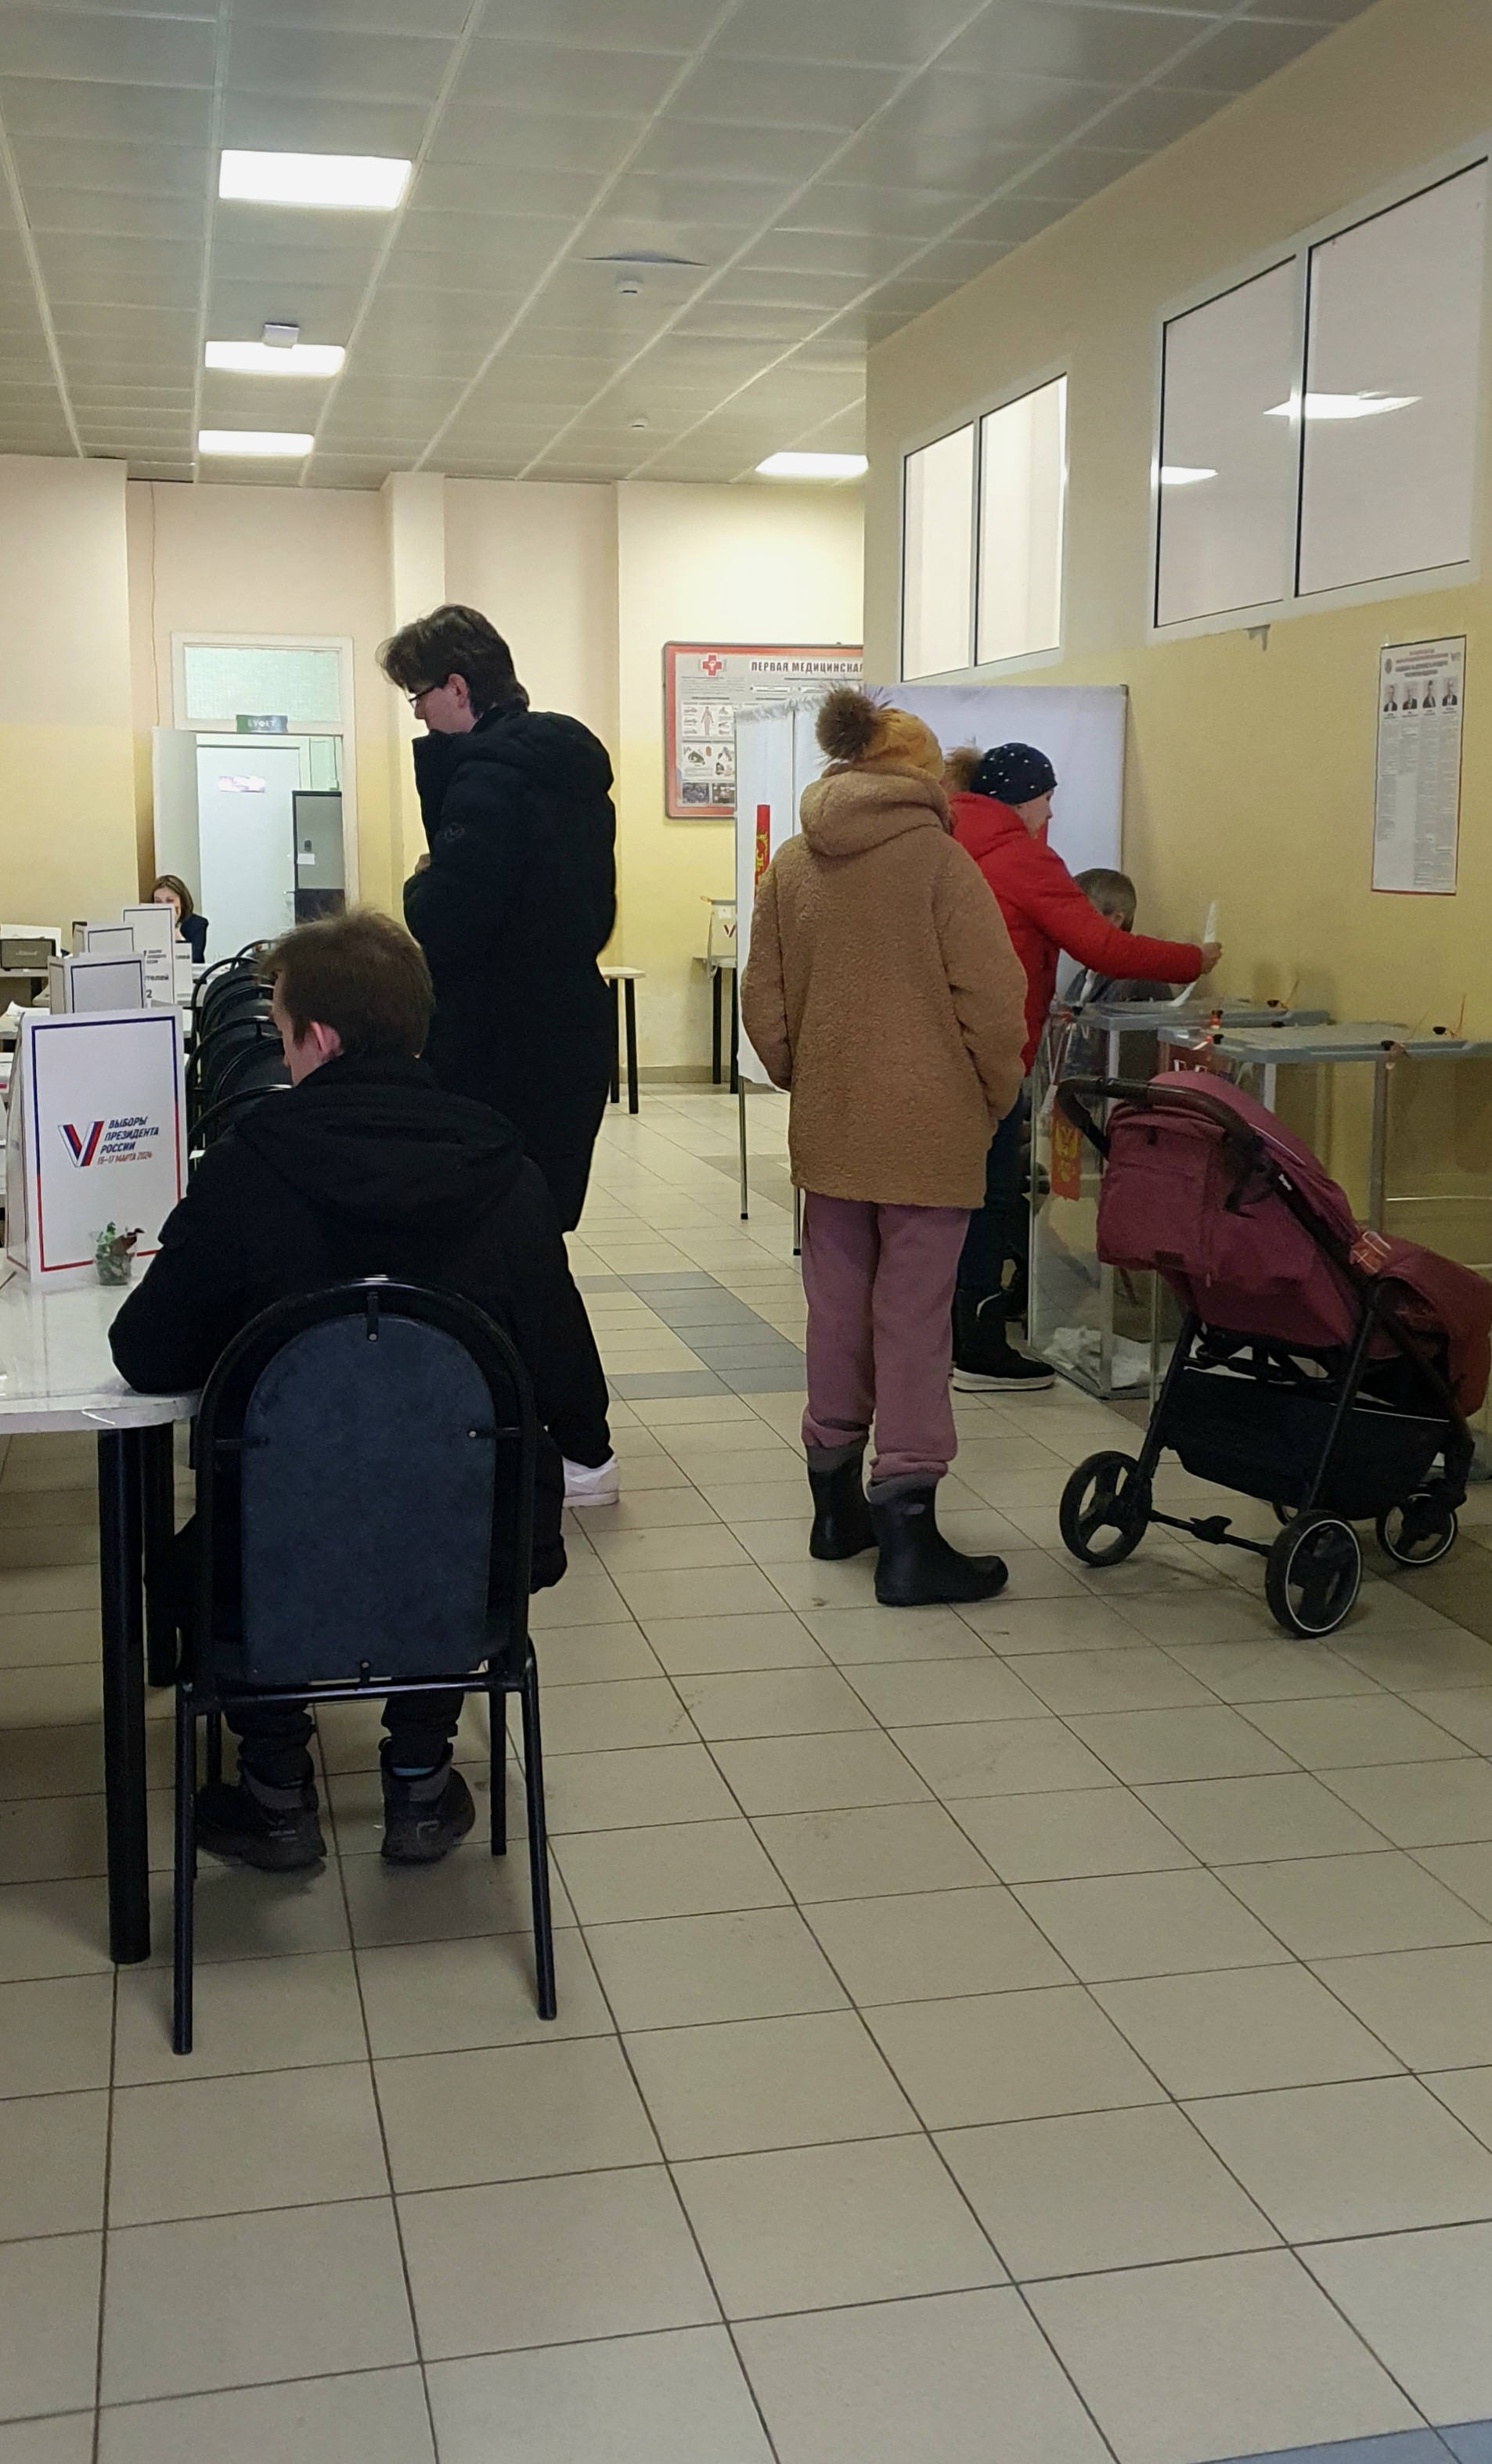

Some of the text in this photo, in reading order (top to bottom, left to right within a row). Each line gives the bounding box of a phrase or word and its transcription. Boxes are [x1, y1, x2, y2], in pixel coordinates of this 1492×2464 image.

[751, 661, 788, 672] ПЕРВАЯ
[108, 1116, 148, 1129] ВЫБОРЫ
[104, 1127, 159, 1141] ПРЕЗИДЕНТА
[100, 1141, 135, 1155] РОССИИ
[115, 1152, 136, 1163] МАРТА
